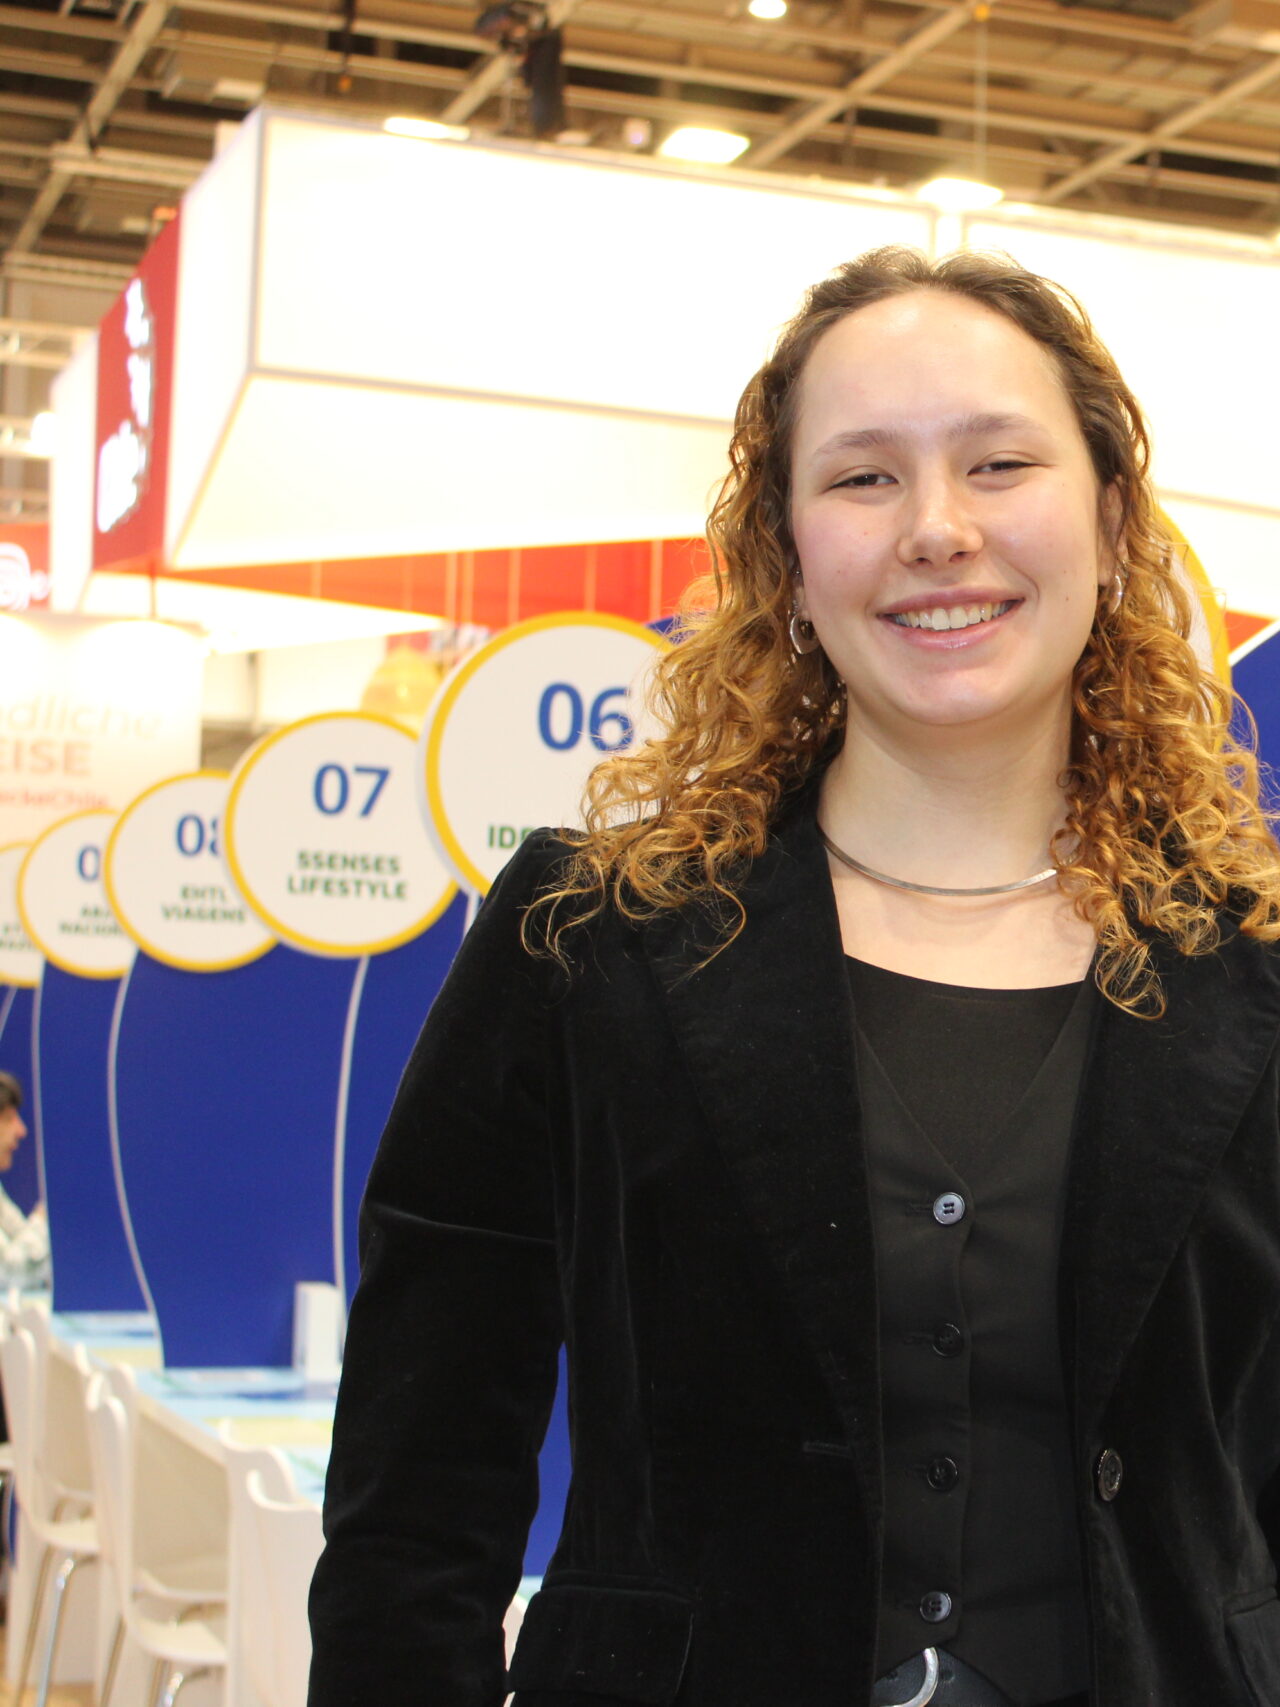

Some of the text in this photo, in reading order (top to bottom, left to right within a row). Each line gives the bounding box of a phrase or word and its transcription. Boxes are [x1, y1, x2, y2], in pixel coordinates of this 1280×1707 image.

[0, 691, 163, 742] dliche
[537, 681, 634, 753] 06
[312, 762, 391, 818] 07
[297, 850, 401, 875] SSENSES
[286, 874, 408, 901] LIFESTYLE
[161, 904, 245, 922] VIAGENS
